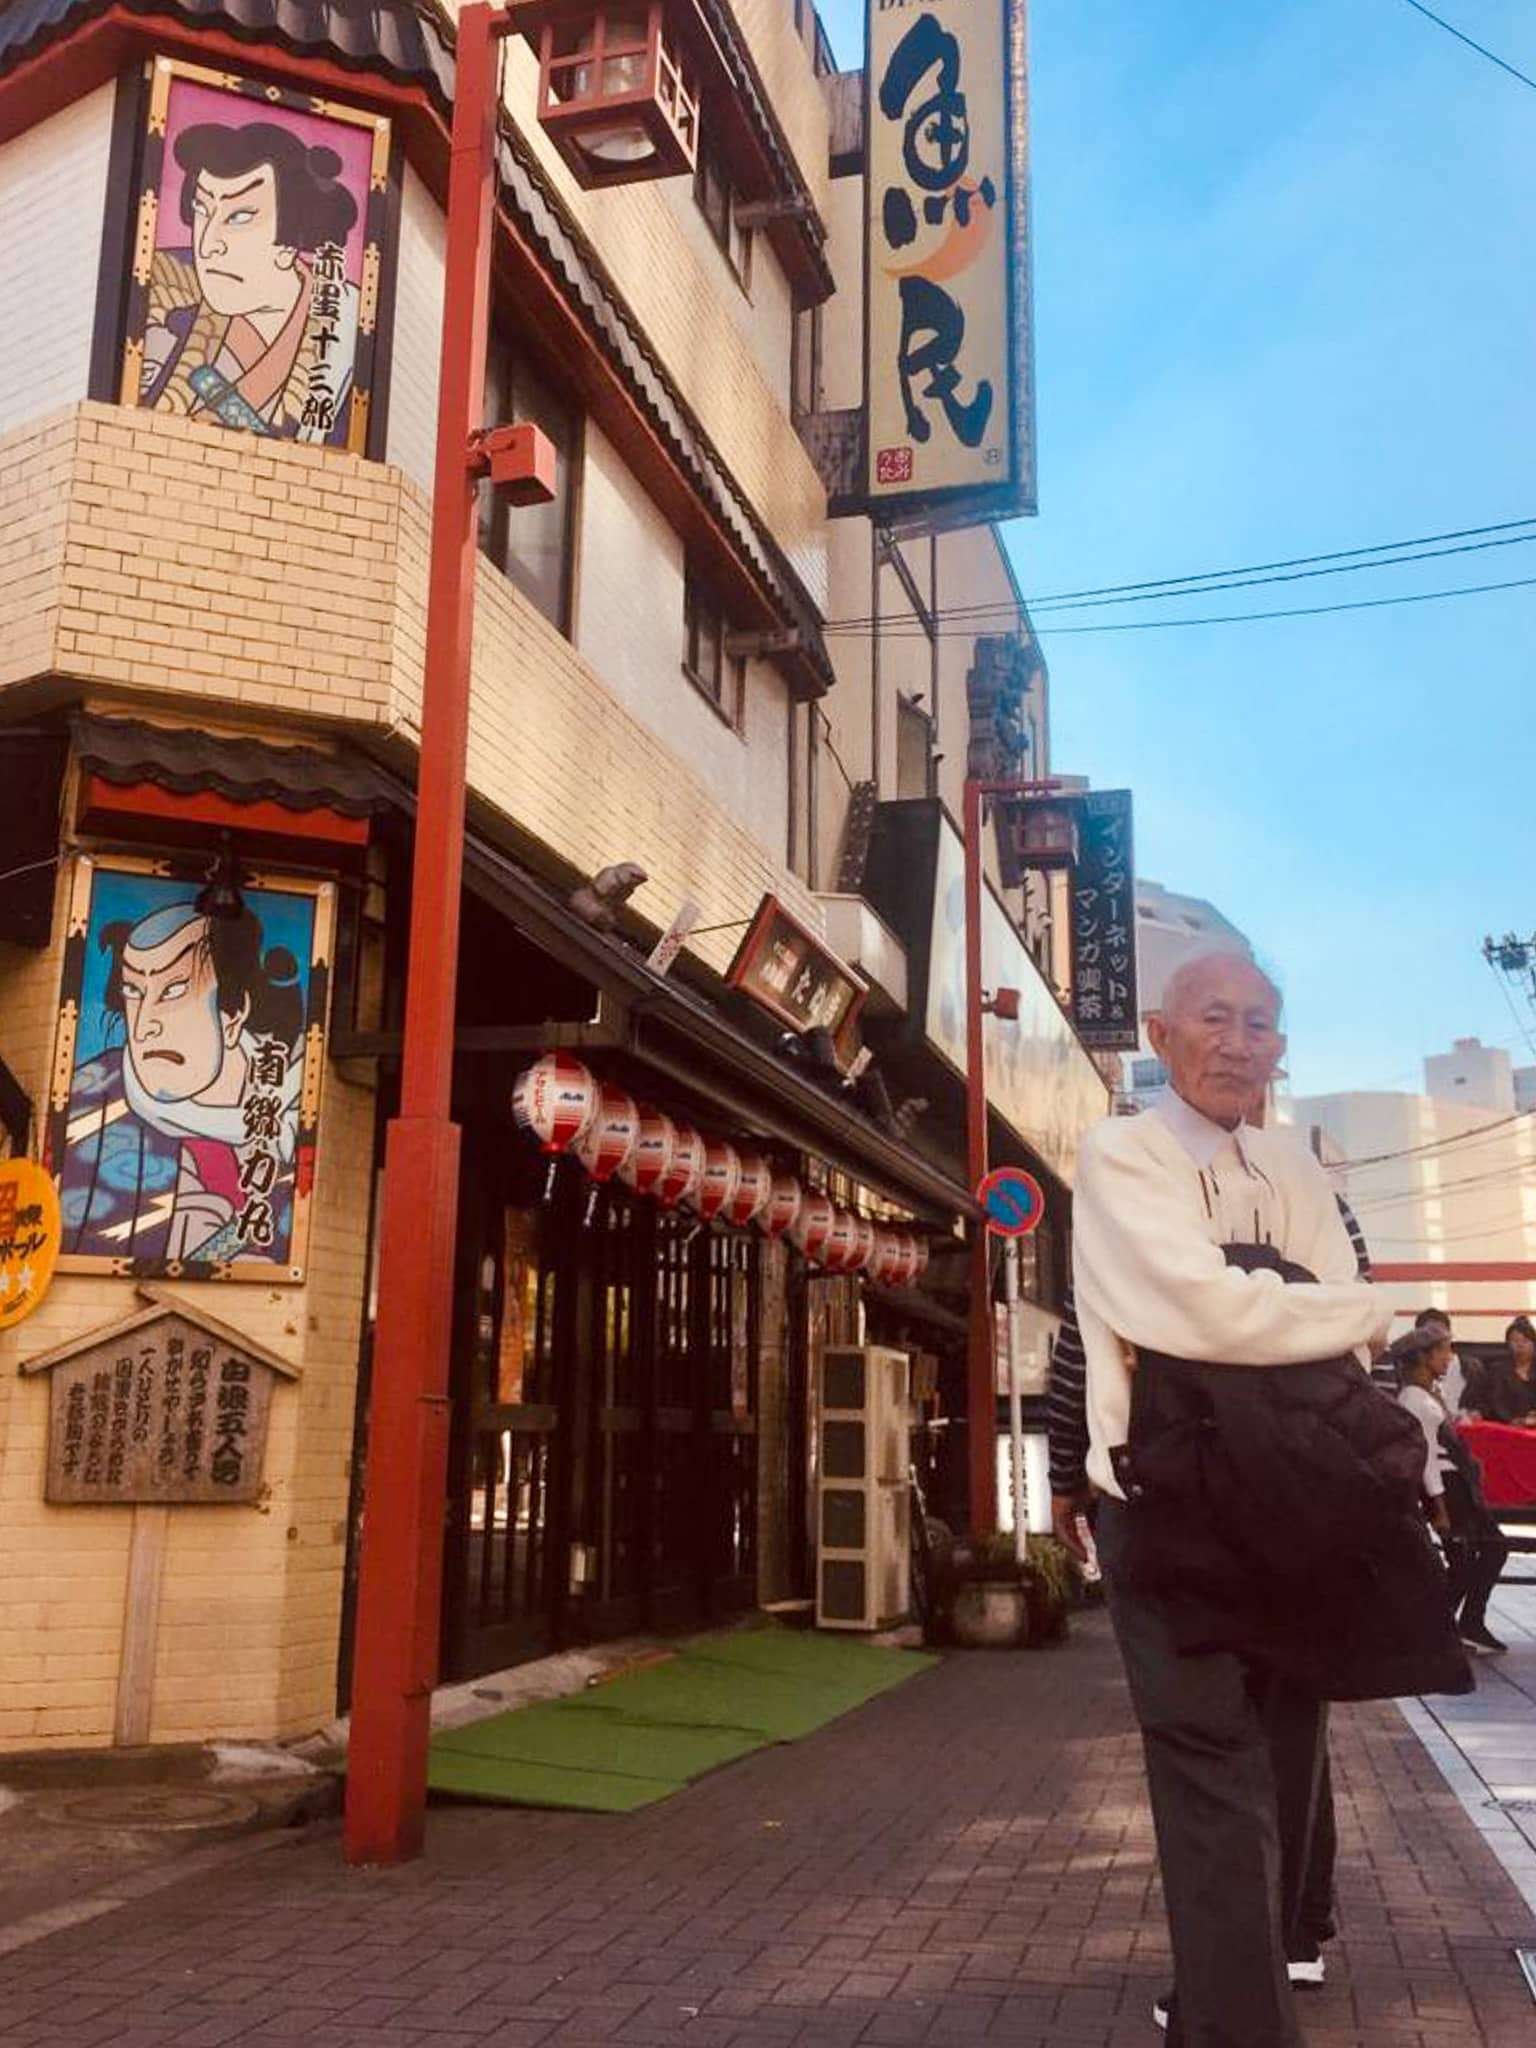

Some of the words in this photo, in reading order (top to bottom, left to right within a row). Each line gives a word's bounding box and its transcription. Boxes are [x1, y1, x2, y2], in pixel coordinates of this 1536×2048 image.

[879, 13, 996, 448] 魚民
[301, 245, 343, 430] 赤星十三郎
[1076, 888, 1102, 1020] マンガ喫茶
[236, 1041, 287, 1244] 南郷力丸
